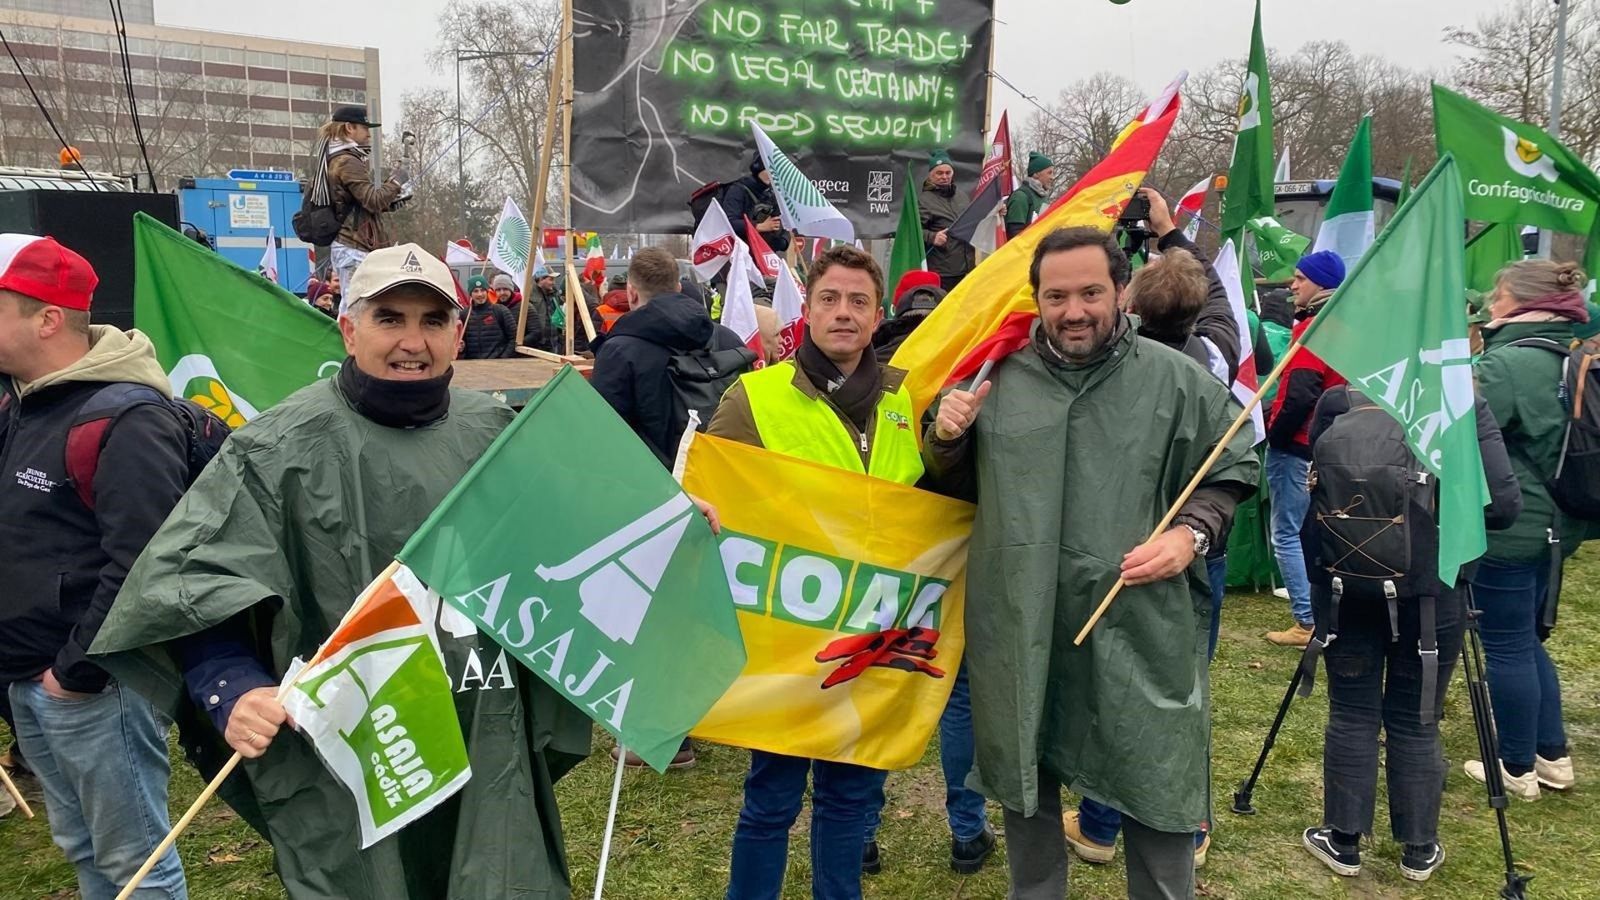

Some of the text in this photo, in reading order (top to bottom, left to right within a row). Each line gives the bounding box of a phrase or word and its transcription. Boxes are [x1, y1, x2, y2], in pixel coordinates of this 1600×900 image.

[712, 7, 761, 37] NO
[779, 13, 849, 50] FAIR
[673, 50, 715, 75] NO
[730, 52, 826, 89] LEGAL
[691, 104, 953, 144] NO FOOD SECURITY!
[811, 180, 849, 195] ogeca
[1468, 179, 1584, 211] Confagricultura
[870, 203, 890, 213] FWA
[718, 536, 950, 632] COAG
[455, 572, 634, 732] ASAJA
[370, 704, 434, 798] ASAJA
